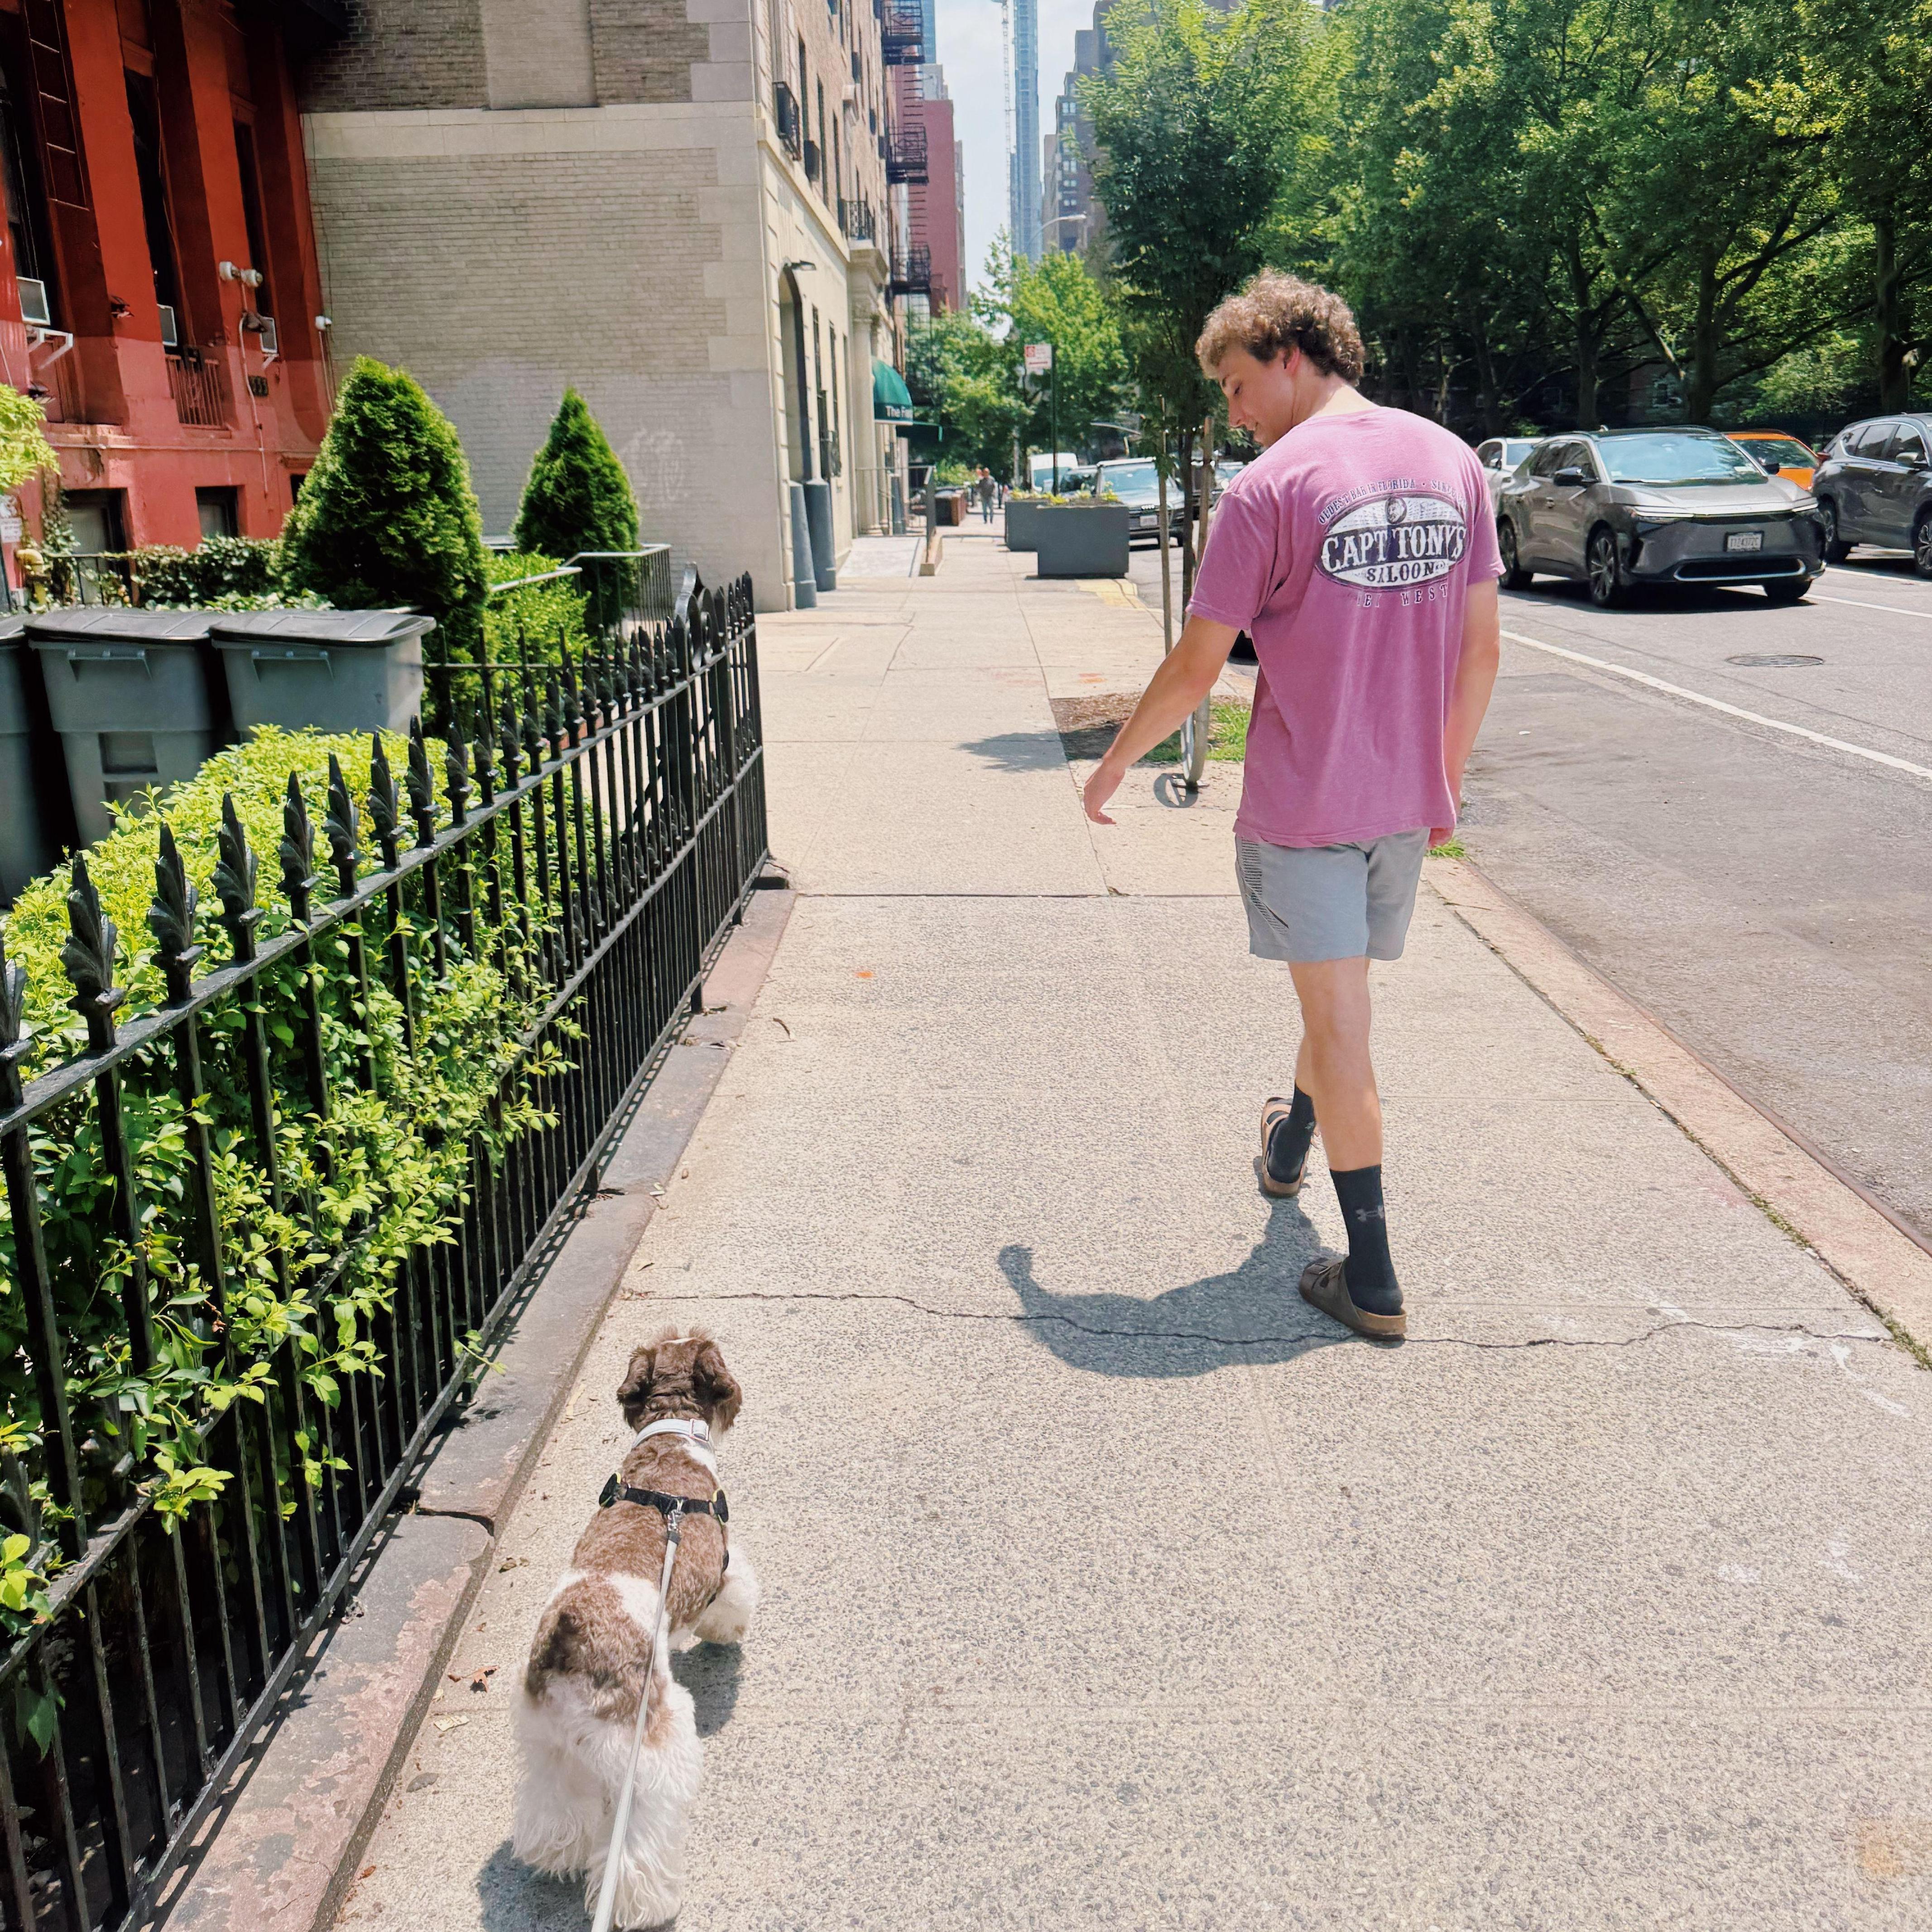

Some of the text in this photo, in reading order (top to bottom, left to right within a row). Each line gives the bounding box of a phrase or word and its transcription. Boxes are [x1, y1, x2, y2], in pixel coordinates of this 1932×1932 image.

[1318, 492, 1351, 525] OLDEST
[1350, 485, 1366, 500] BAR
[1378, 478, 1417, 492] FLORIDA
[1321, 530, 1388, 572] CAPT
[1366, 561, 1435, 583] SALOON
[1401, 583, 1448, 607] WEST
